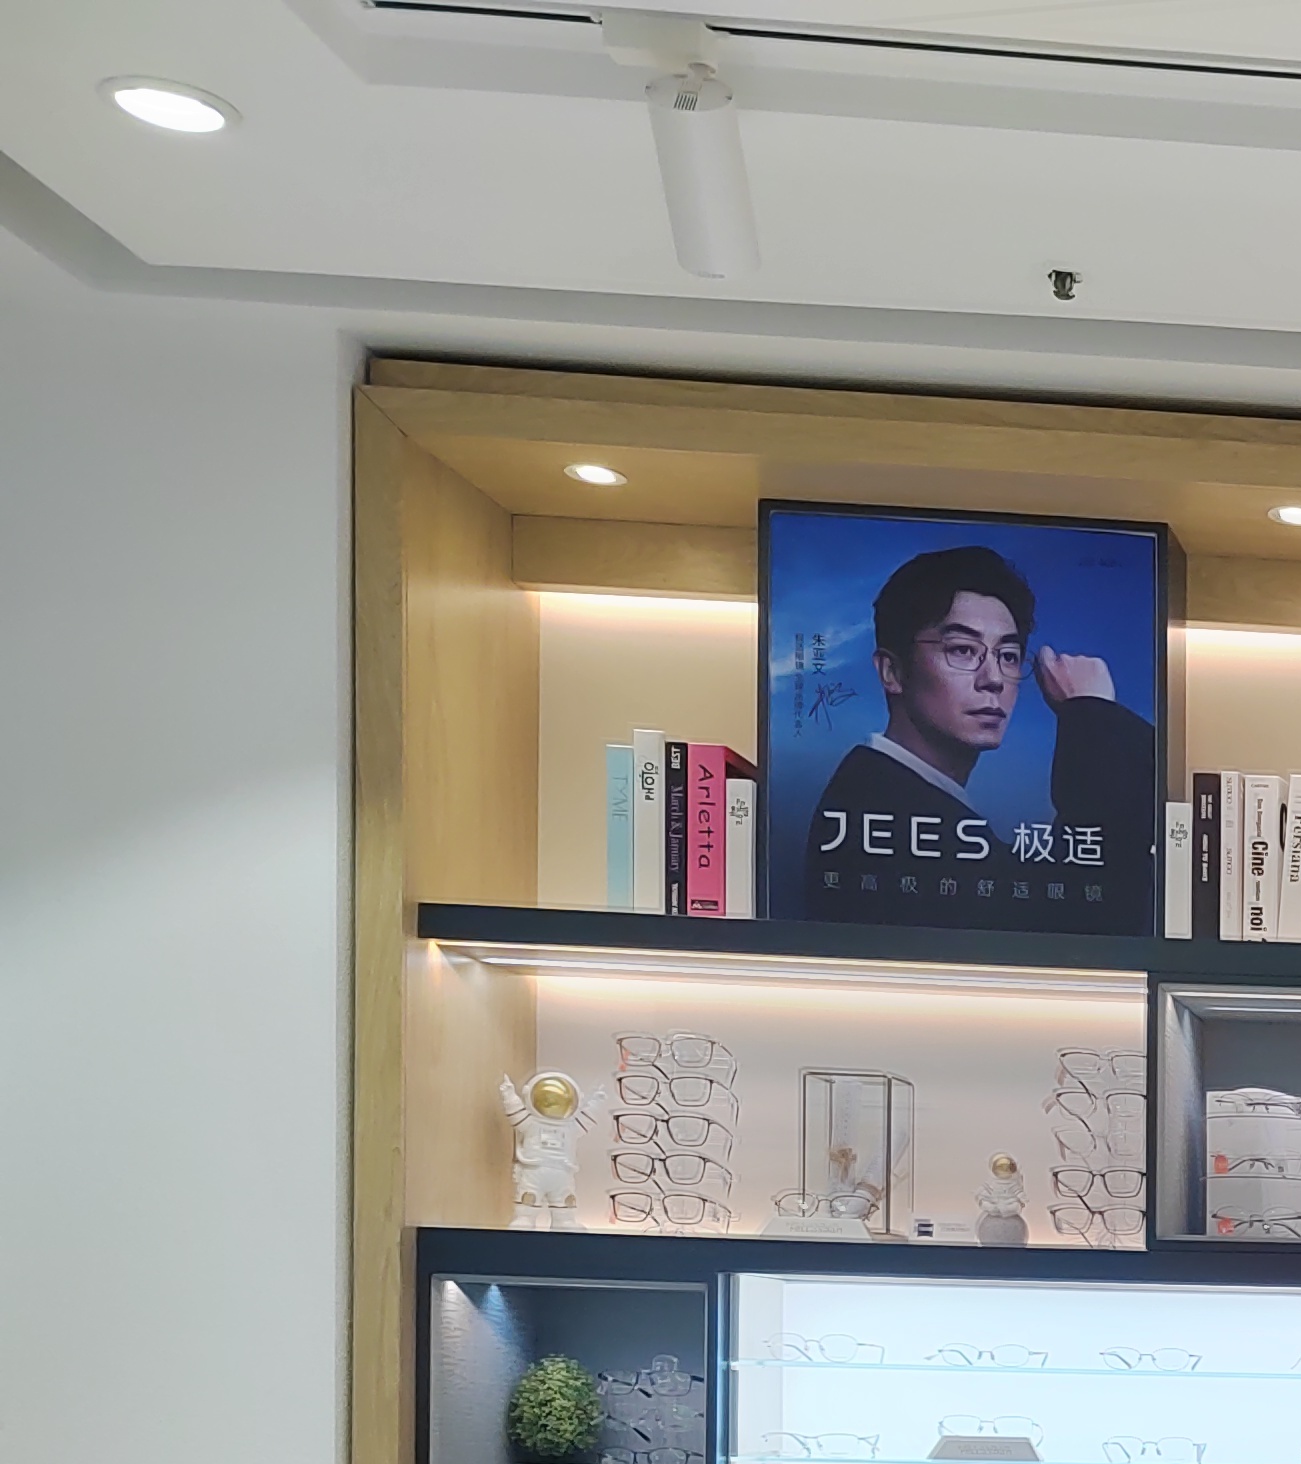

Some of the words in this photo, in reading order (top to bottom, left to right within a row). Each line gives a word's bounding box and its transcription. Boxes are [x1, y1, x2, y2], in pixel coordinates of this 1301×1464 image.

[698, 763, 716, 869] Arletta
[820, 810, 991, 860] JEES
[1011, 822, 1105, 866] 极适
[1251, 840, 1269, 877] Cine
